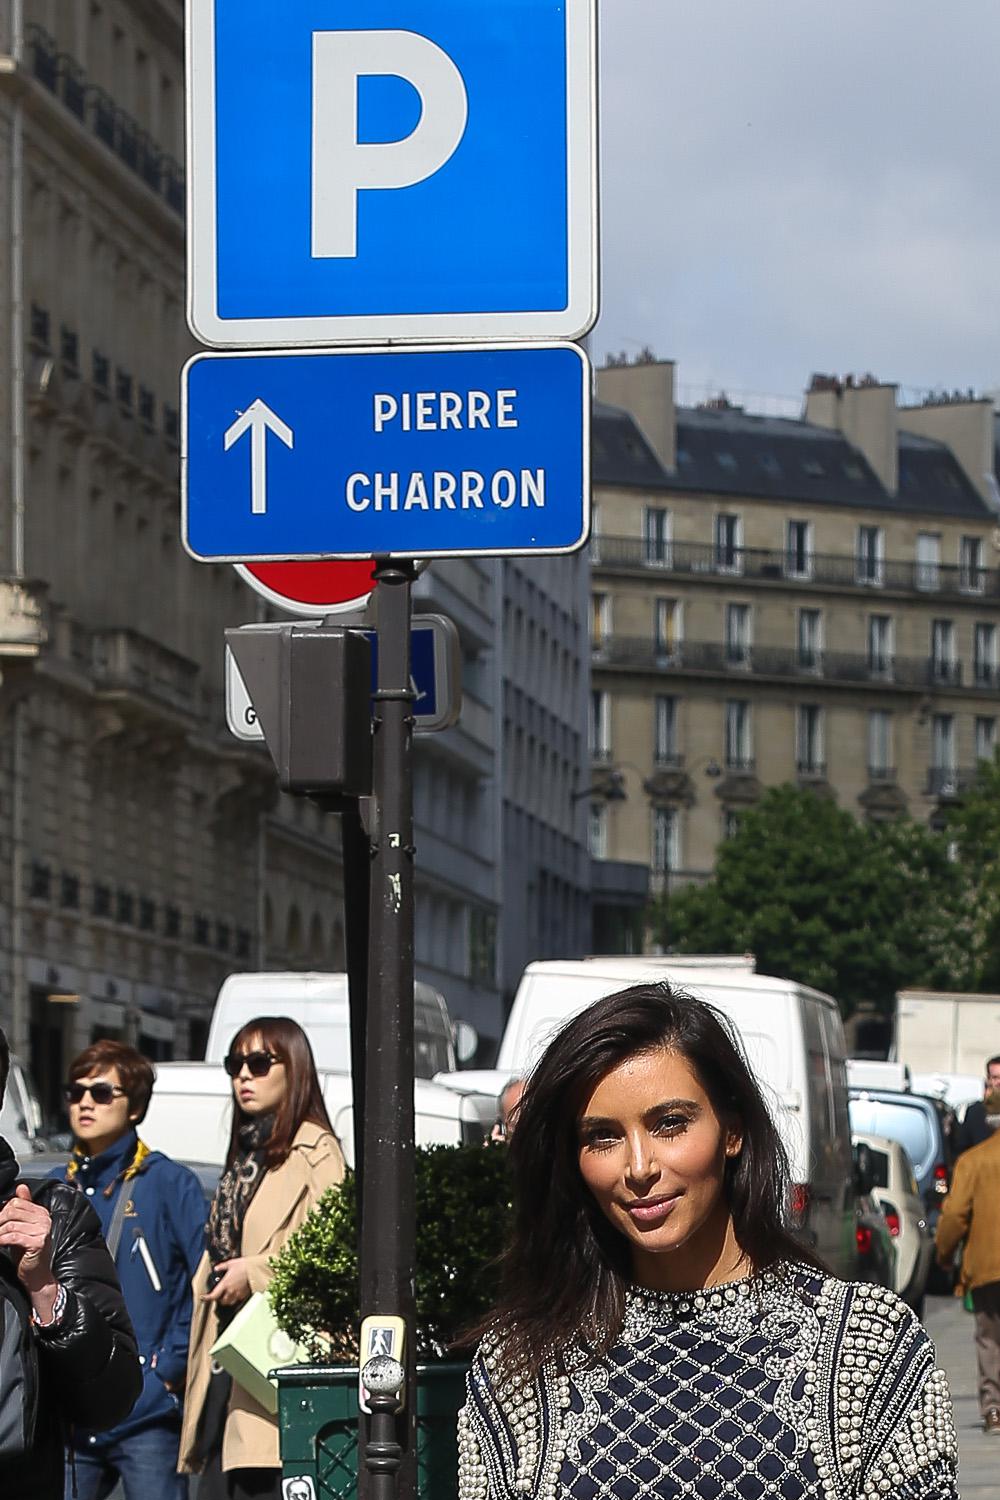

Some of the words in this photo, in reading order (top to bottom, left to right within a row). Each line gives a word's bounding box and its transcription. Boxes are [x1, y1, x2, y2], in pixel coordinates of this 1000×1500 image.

[311, 29, 468, 258] P
[373, 389, 518, 432] PIERRE
[346, 469, 545, 512] CHARRON
